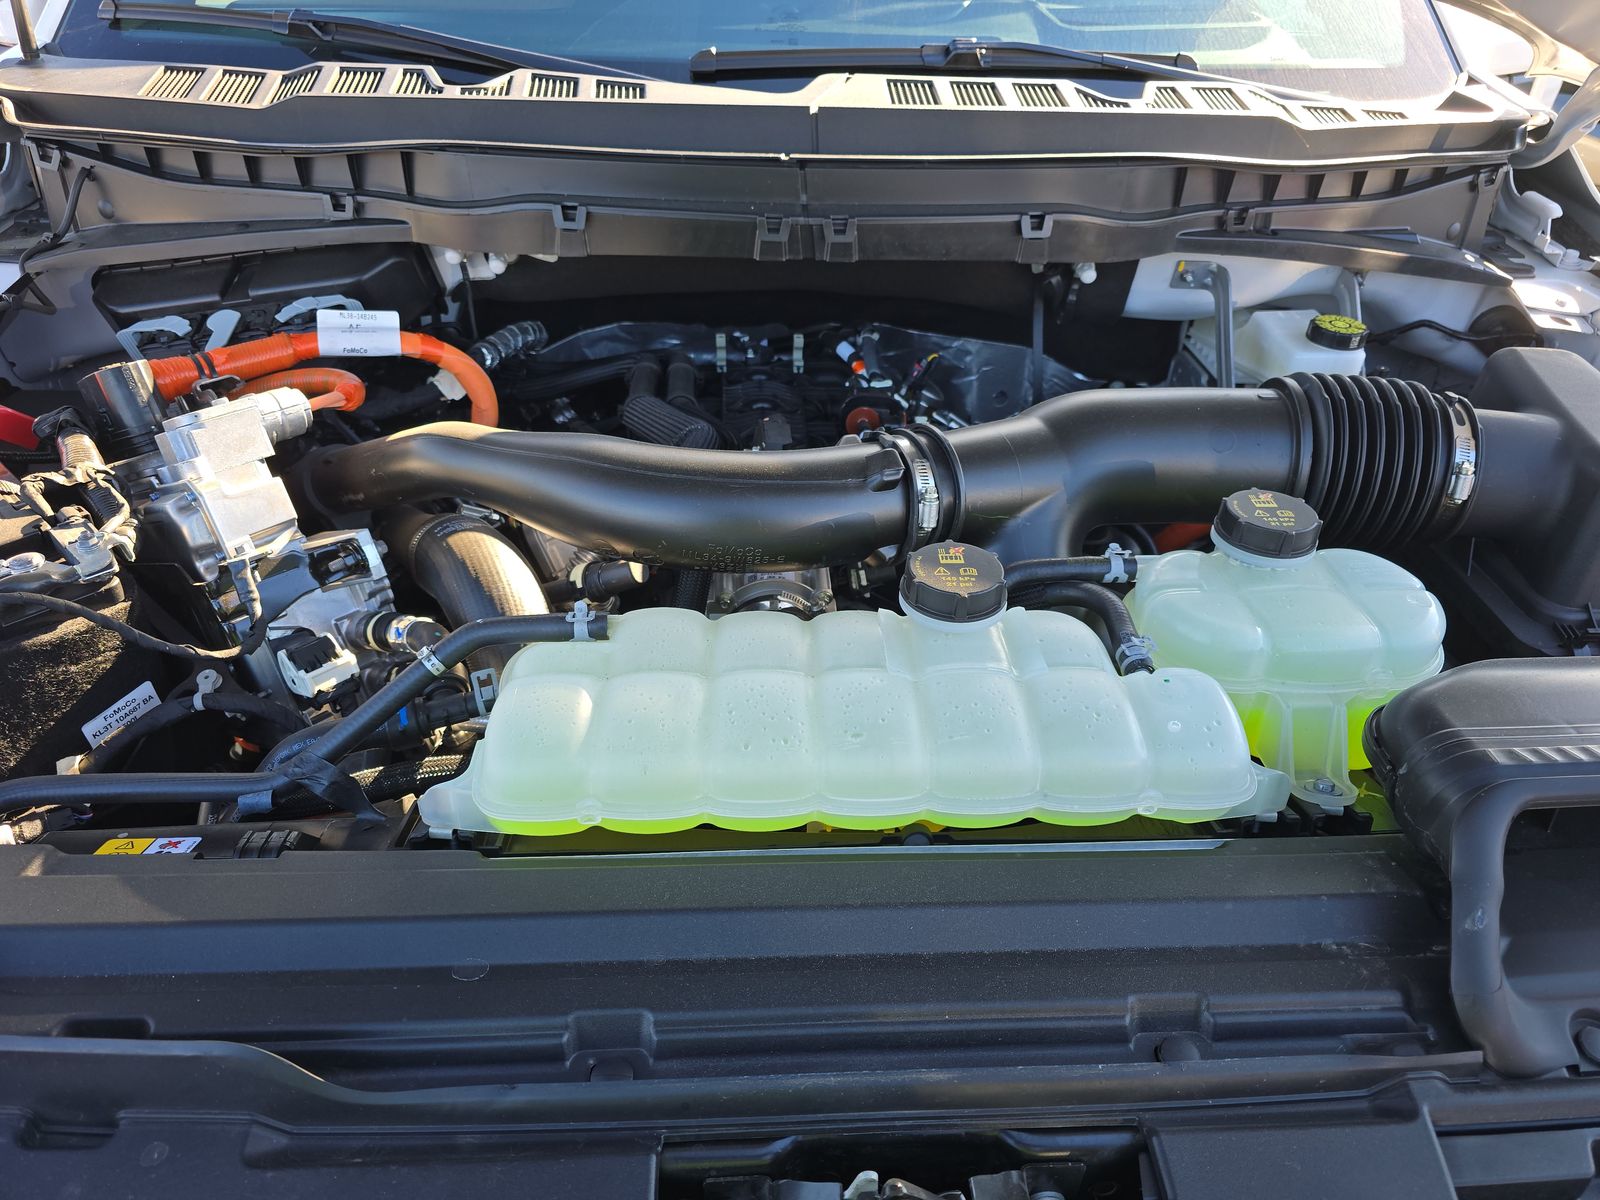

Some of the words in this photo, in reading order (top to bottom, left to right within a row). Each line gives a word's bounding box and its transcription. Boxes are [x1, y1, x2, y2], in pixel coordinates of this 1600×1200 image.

[92, 722, 113, 739] KL3T
[115, 703, 141, 724] 10A687
[142, 695, 154, 705] BA
[103, 698, 137, 722] FoMoCo
